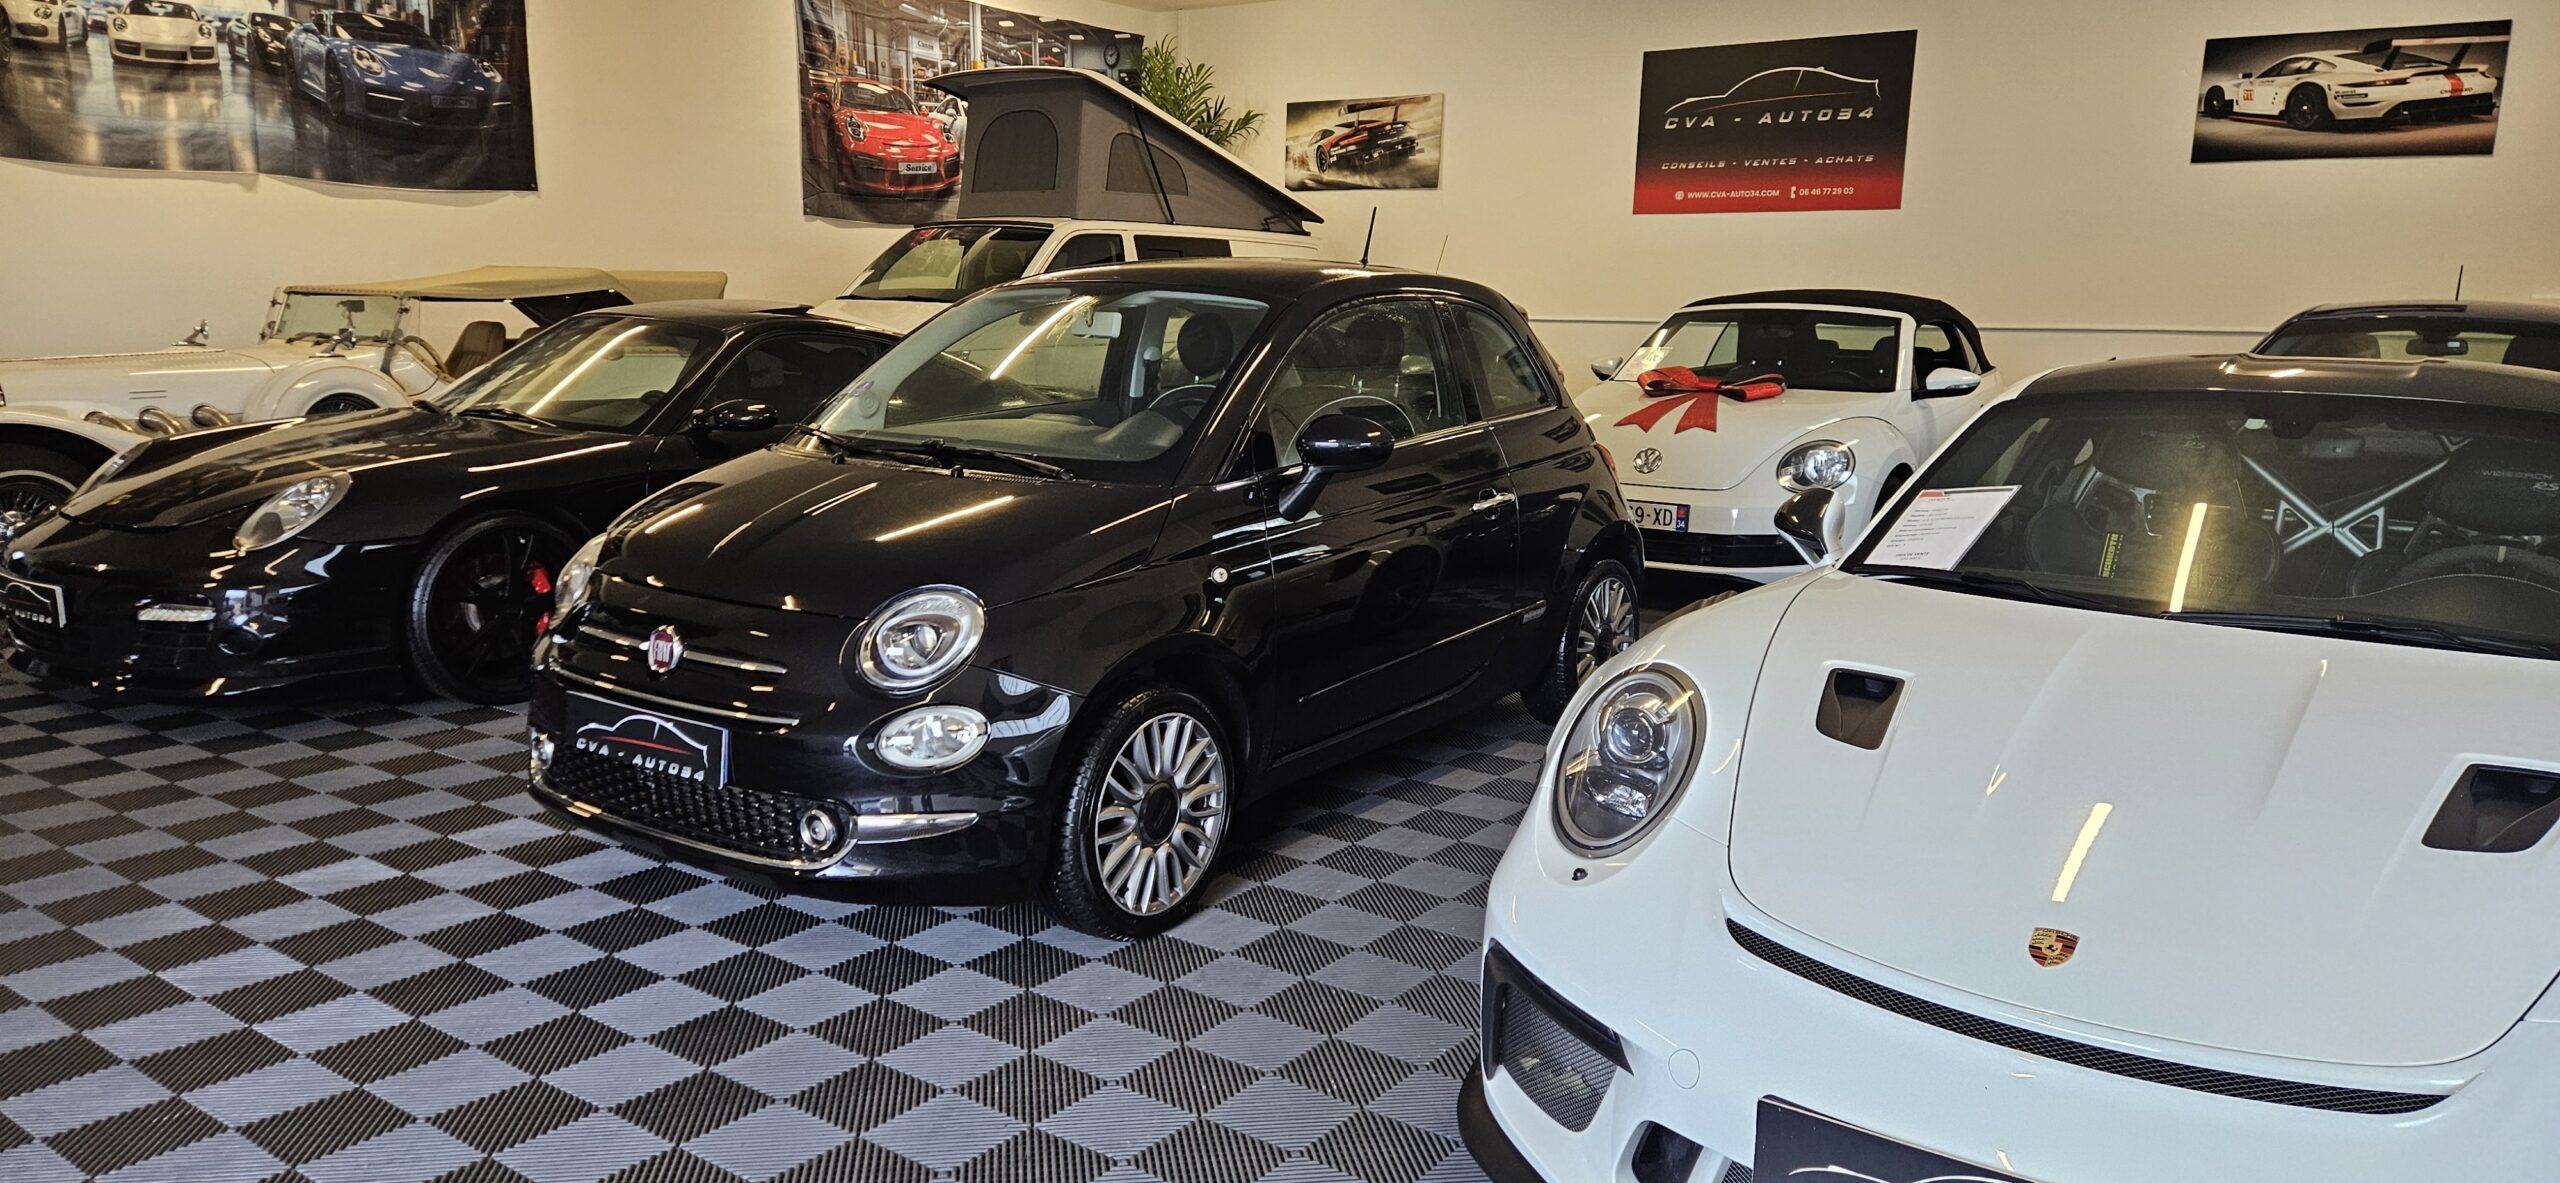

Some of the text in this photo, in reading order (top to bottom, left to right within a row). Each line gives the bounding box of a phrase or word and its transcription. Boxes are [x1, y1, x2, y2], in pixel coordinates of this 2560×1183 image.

[1664, 115, 1716, 130] CVA
[1757, 106, 1874, 126] AUTO34
[1661, 160, 1726, 170] CONSEILS
[1744, 157, 1798, 167] VENTES
[1815, 154, 1875, 165] ACHATS
[1687, 189, 1780, 199] WWW.CVA-AUTO34.COM
[1799, 186, 1854, 196] 06 46 77 29 03
[1629, 505, 1673, 527] 9-XD
[1676, 519, 1686, 528] 34
[653, 639, 673, 663] FIAT
[576, 737, 609, 756] CVA
[632, 753, 705, 782] AUTO34
